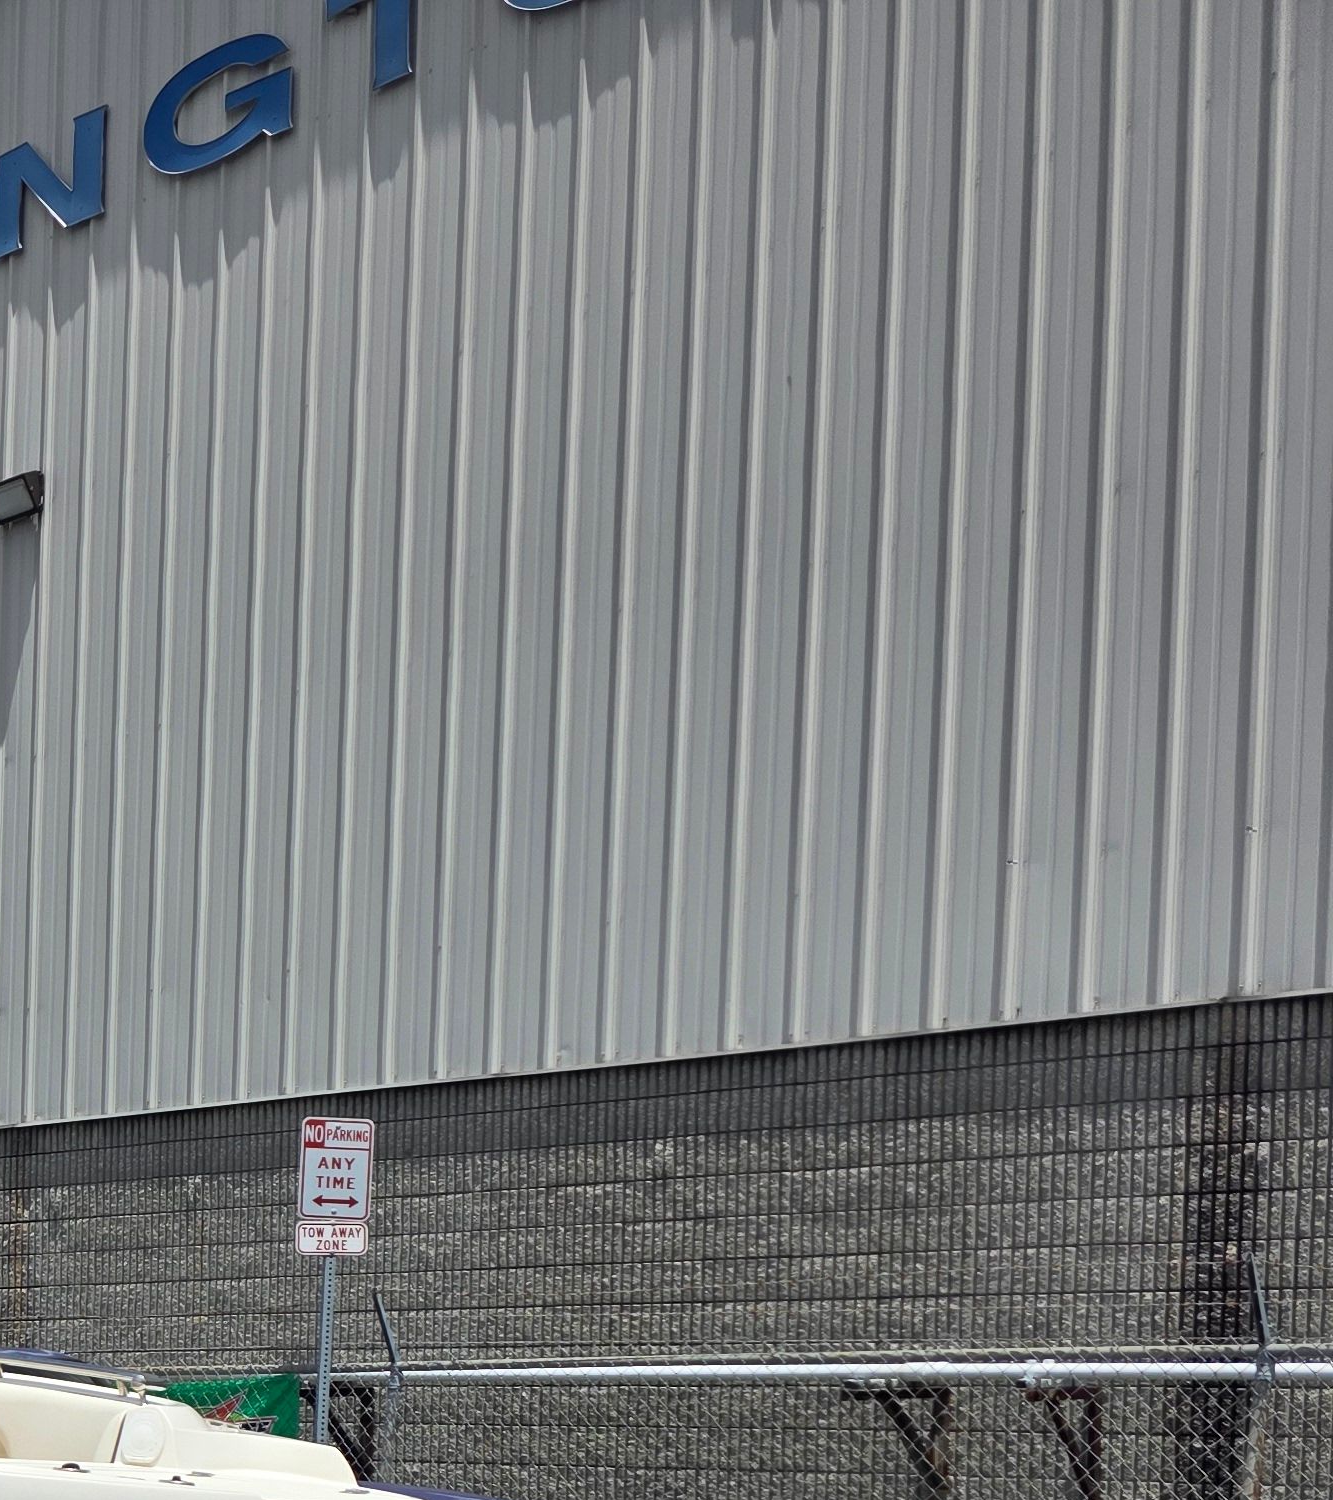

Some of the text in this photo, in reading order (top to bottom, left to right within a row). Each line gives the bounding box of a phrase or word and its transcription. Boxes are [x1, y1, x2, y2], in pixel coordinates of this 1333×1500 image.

[305, 1124, 369, 1143] NO PARKING
[317, 1156, 356, 1171] ANY
[315, 1175, 356, 1190] TIME
[301, 1226, 362, 1239] TOW AWAY
[315, 1239, 348, 1251] ZONE
